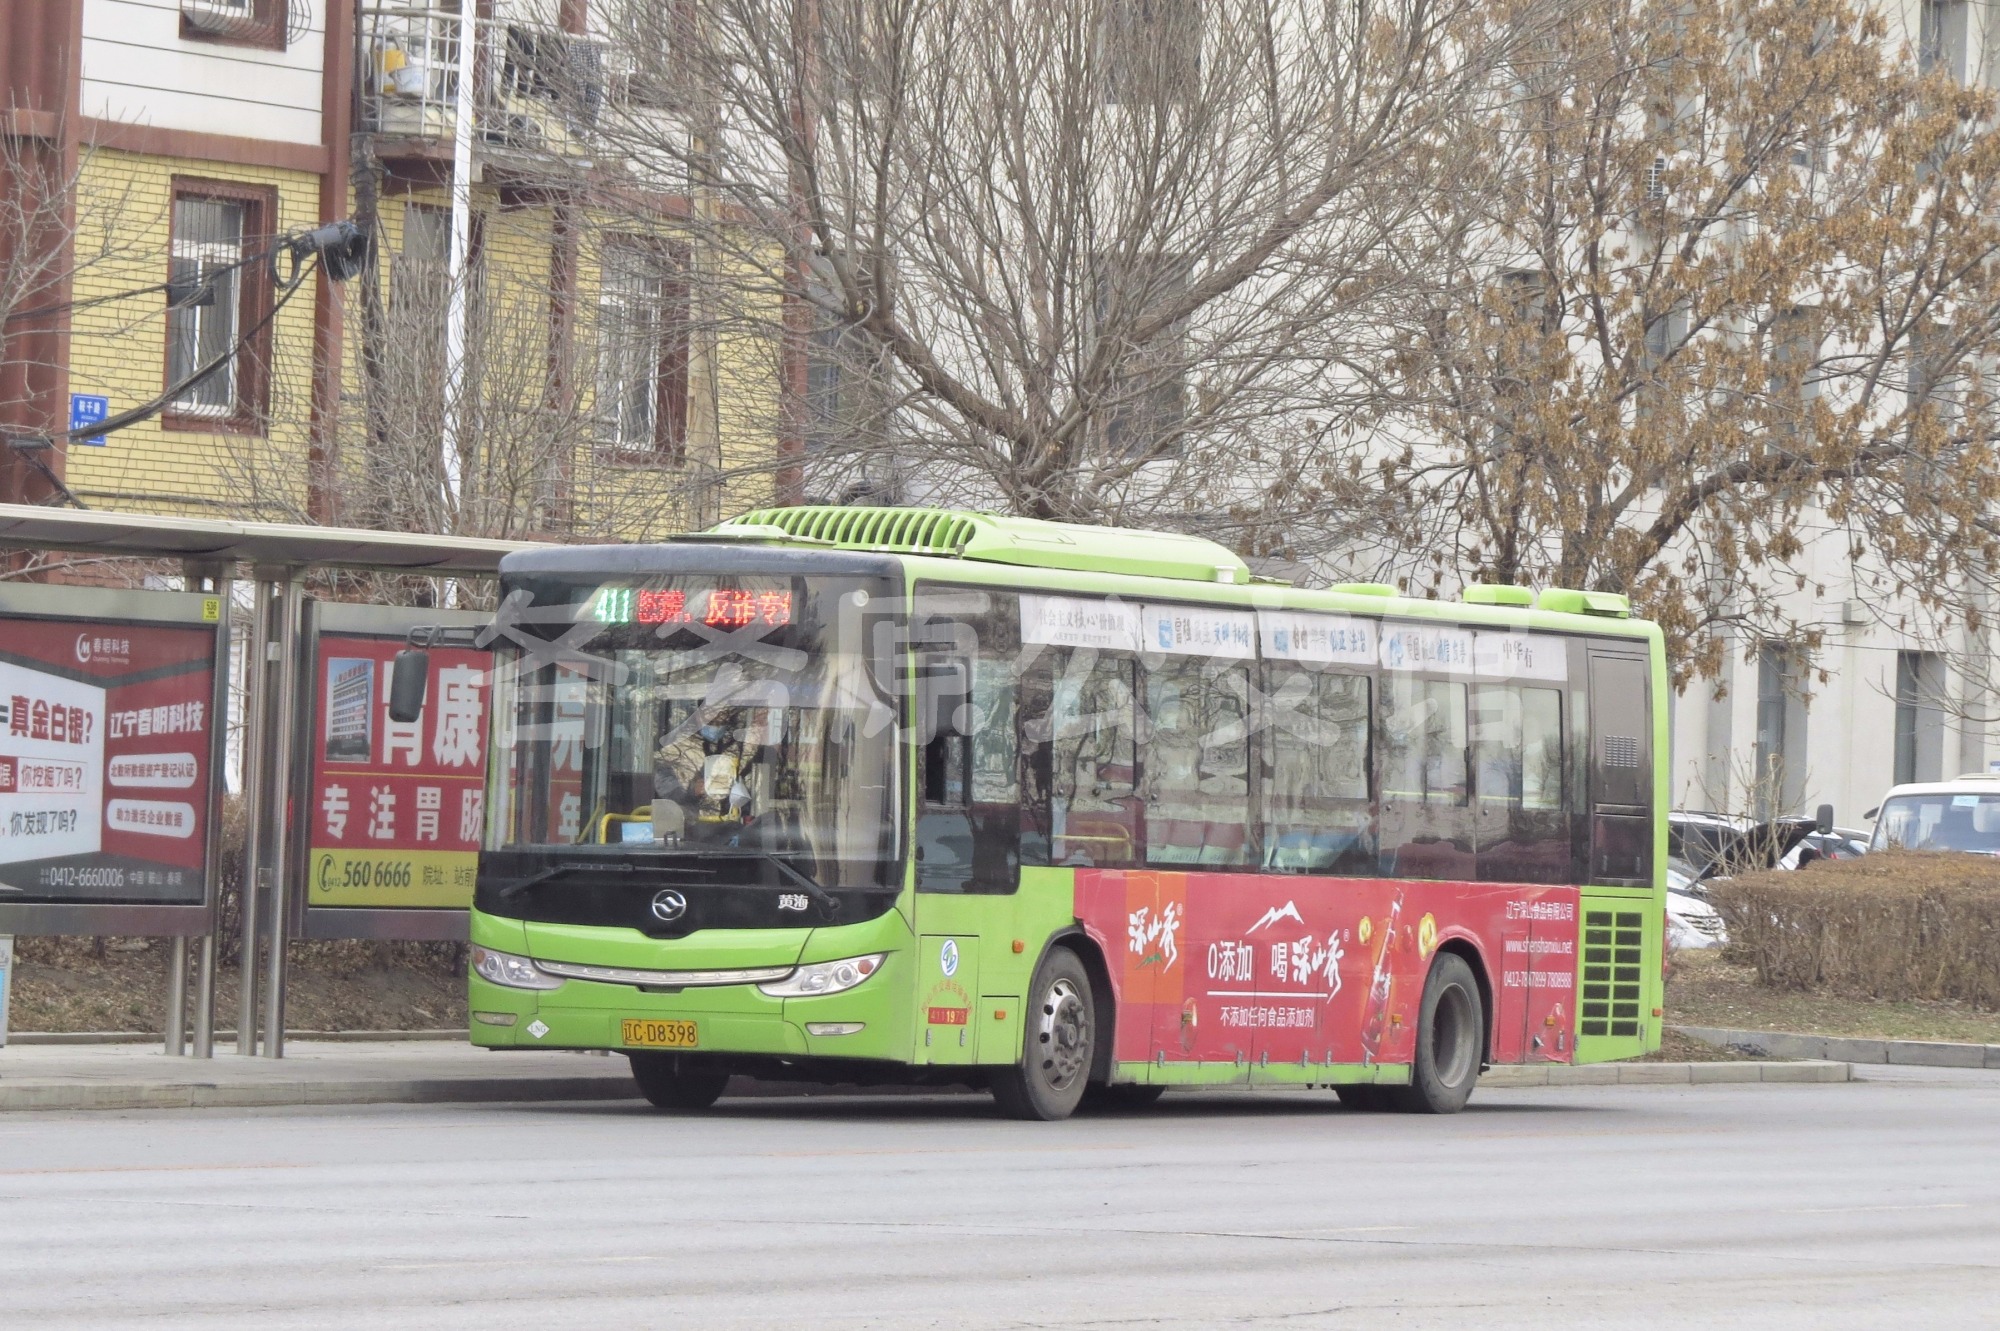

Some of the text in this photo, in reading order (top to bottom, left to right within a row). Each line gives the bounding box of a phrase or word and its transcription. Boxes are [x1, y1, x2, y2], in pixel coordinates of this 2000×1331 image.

[594, 589, 631, 623] 411
[110, 701, 204, 739] 辽宁春明科技
[21, 765, 83, 790] 你挖掘了吗？
[50, 867, 124, 887] 0412-6660006
[778, 894, 809, 911] 黄海
[1506, 901, 1574, 922] 辽宁深山食品有限公司
[1207, 940, 1253, 982] 0添加
[1220, 1006, 1315, 1029] 不添加任何食品添加剂
[530, 1026, 546, 1034] LNG
[624, 1023, 697, 1045] 辽C·D8398
